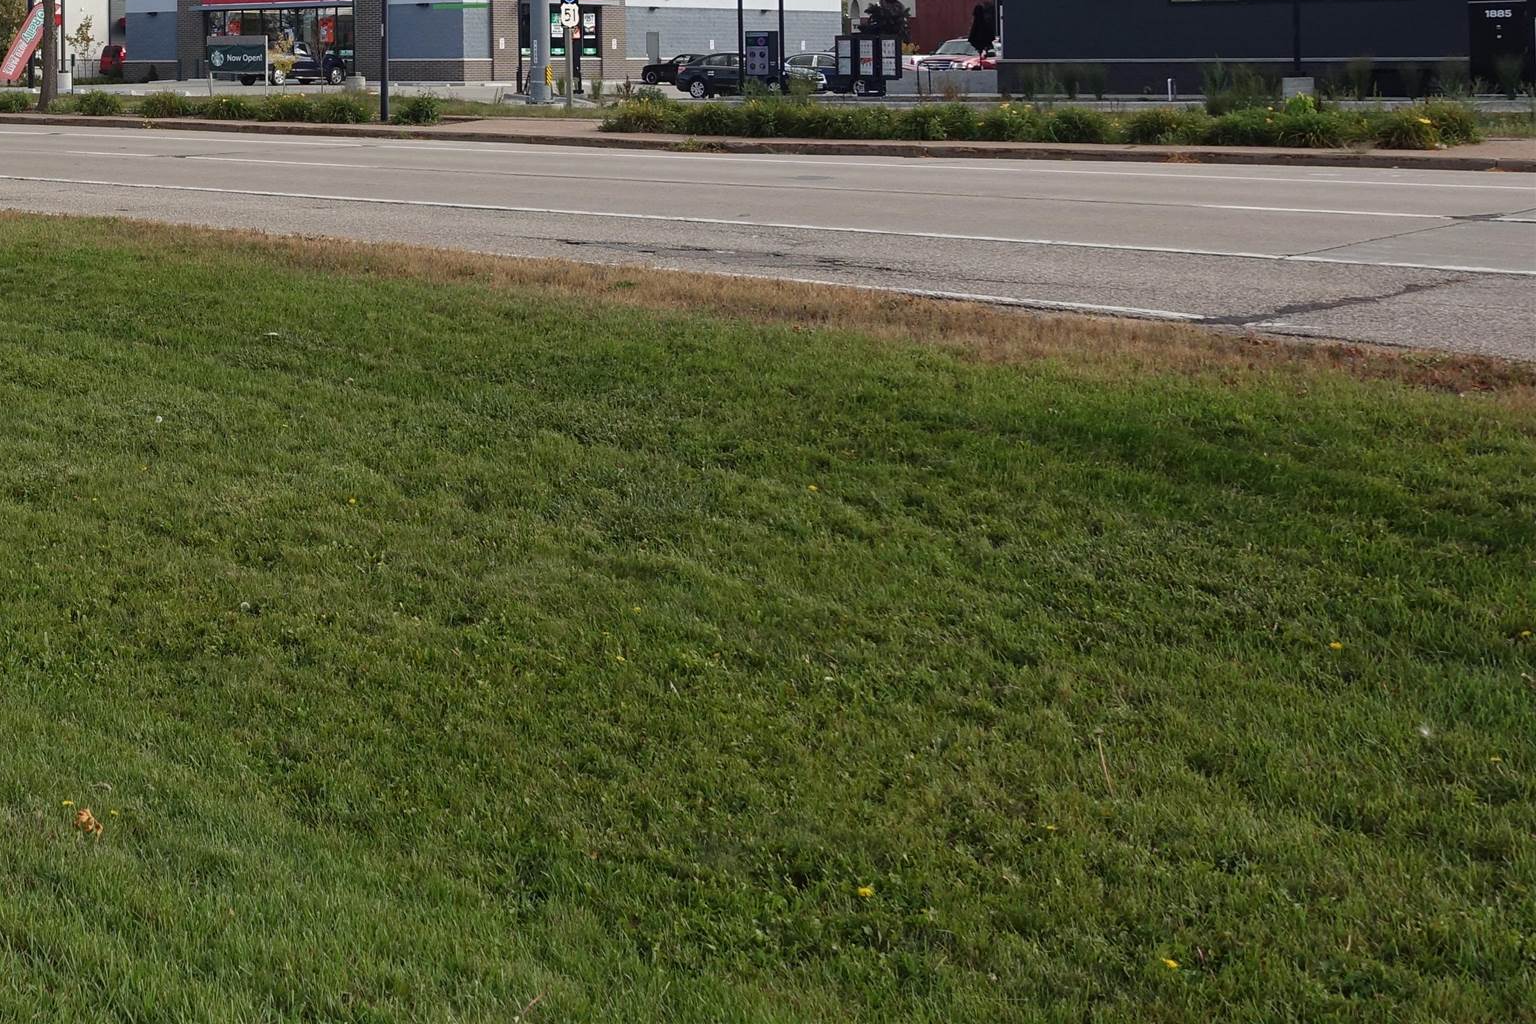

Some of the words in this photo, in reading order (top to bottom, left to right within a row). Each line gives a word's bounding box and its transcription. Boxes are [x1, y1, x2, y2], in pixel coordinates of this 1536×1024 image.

[564, 8, 576, 22] 51
[1484, 9, 1512, 18] 1885
[226, 53, 242, 62] Now
[243, 54, 263, 64] Open!
